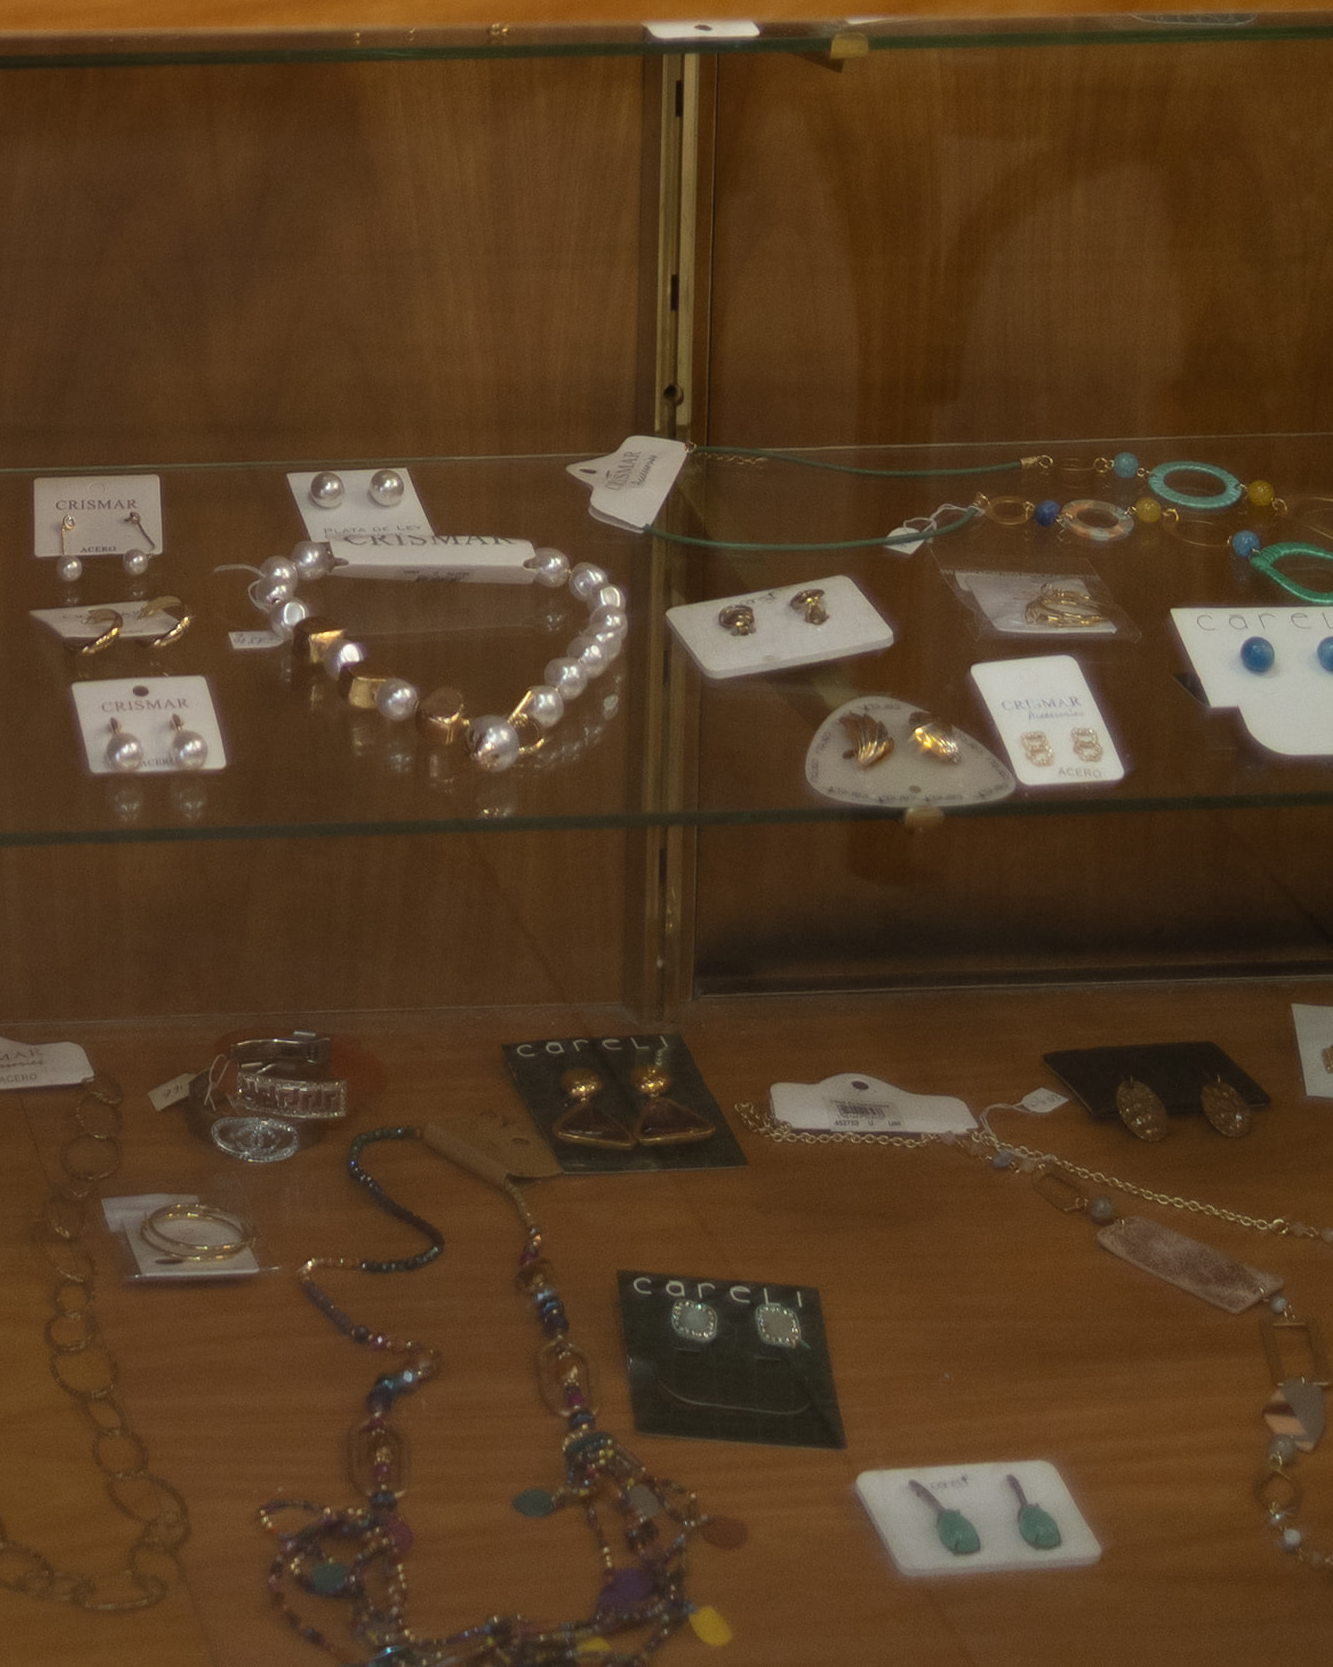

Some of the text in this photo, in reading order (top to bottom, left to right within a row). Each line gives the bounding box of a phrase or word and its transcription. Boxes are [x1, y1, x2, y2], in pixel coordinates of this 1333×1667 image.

[605, 450, 642, 492] CRISMAR
[55, 497, 139, 512] CRISMAR
[372, 525, 392, 534] DE
[396, 524, 422, 533] LEY
[80, 544, 117, 554] ACERO
[100, 697, 189, 713] CRISMAR
[1001, 696, 1081, 712] CRISMAR
[1058, 768, 1101, 779] ACERO
